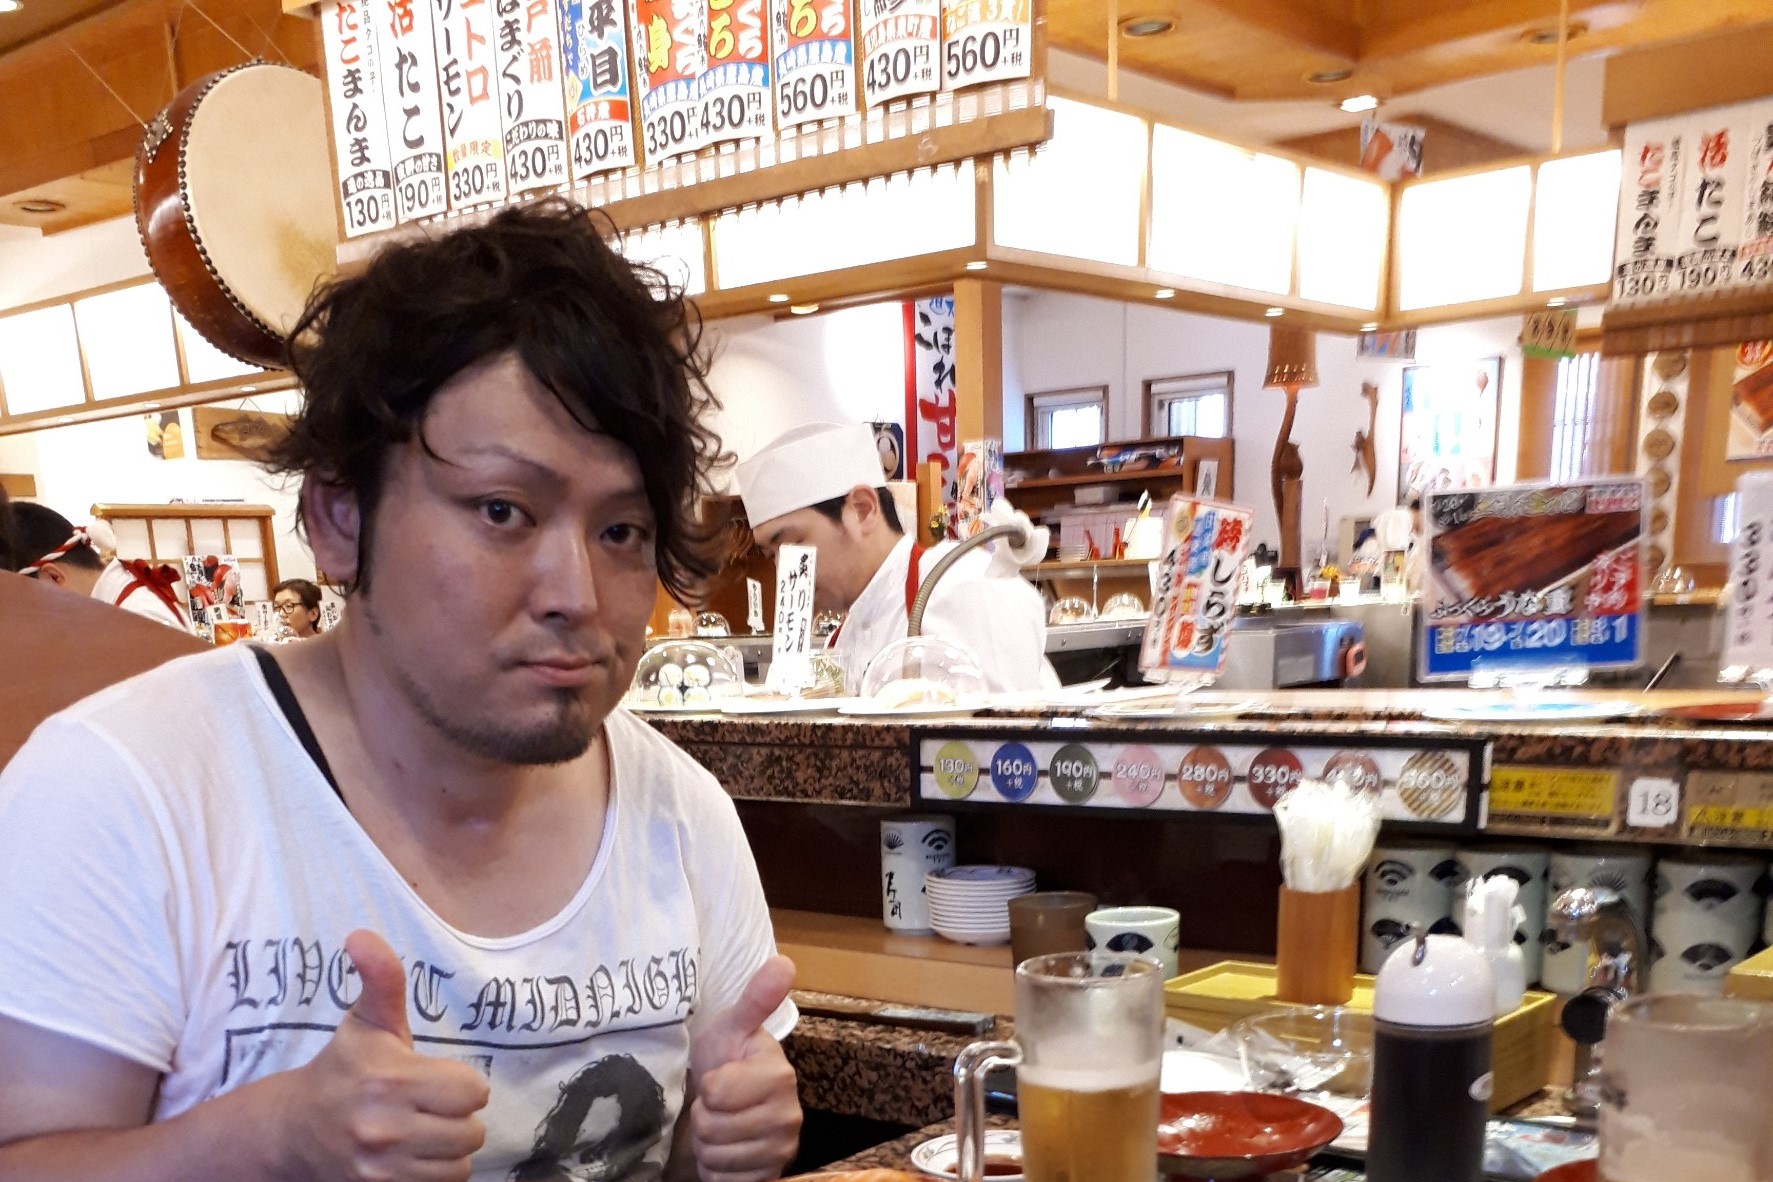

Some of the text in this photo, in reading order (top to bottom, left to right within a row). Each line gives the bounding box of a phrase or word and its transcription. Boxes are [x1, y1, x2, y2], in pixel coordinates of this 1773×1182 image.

[335, 1, 371, 167] たこまんま
[460, 0, 490, 106] トロ
[1637, 789, 1673, 817] 18
[460, 946, 701, 1033] MIDNIGH
